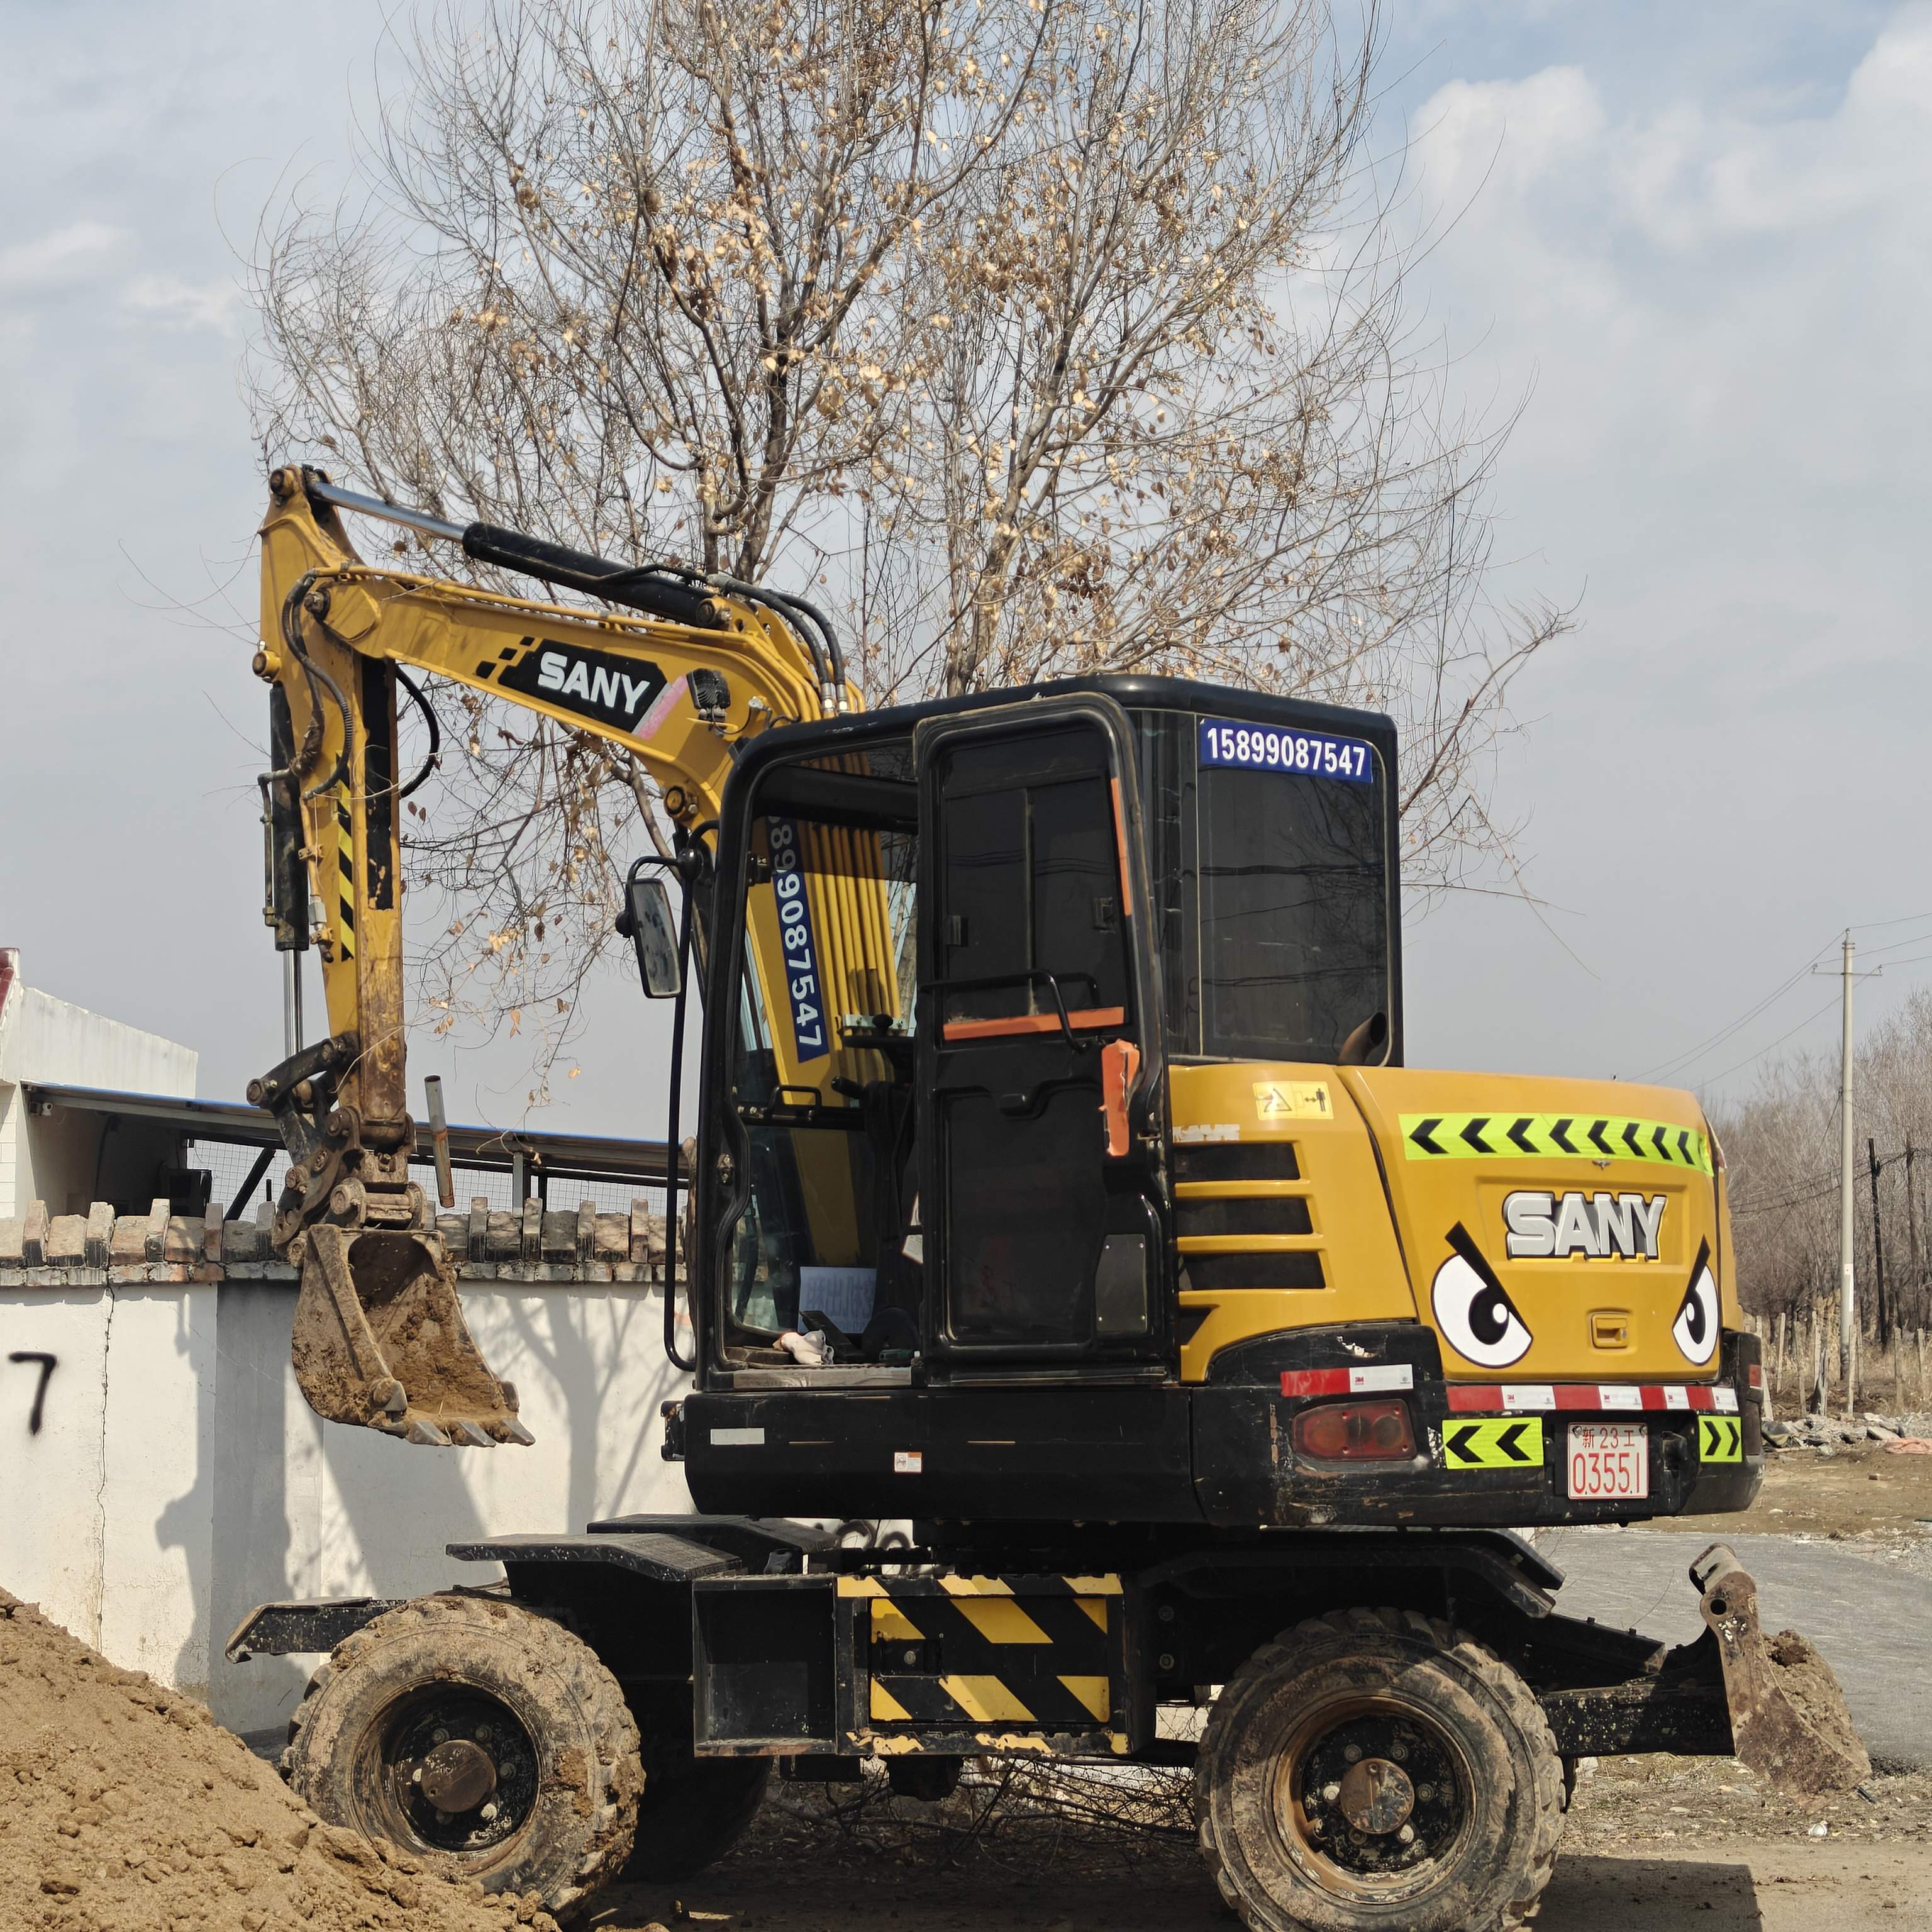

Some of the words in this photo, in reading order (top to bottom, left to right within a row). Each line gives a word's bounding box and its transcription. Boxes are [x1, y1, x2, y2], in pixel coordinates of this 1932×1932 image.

[538, 651, 650, 714] SANY
[1207, 727, 1365, 776] 15899087547
[1502, 1191, 1667, 1258] SANY
[8, 1351, 58, 1436] 7
[1573, 1452, 1640, 1494] 03551
